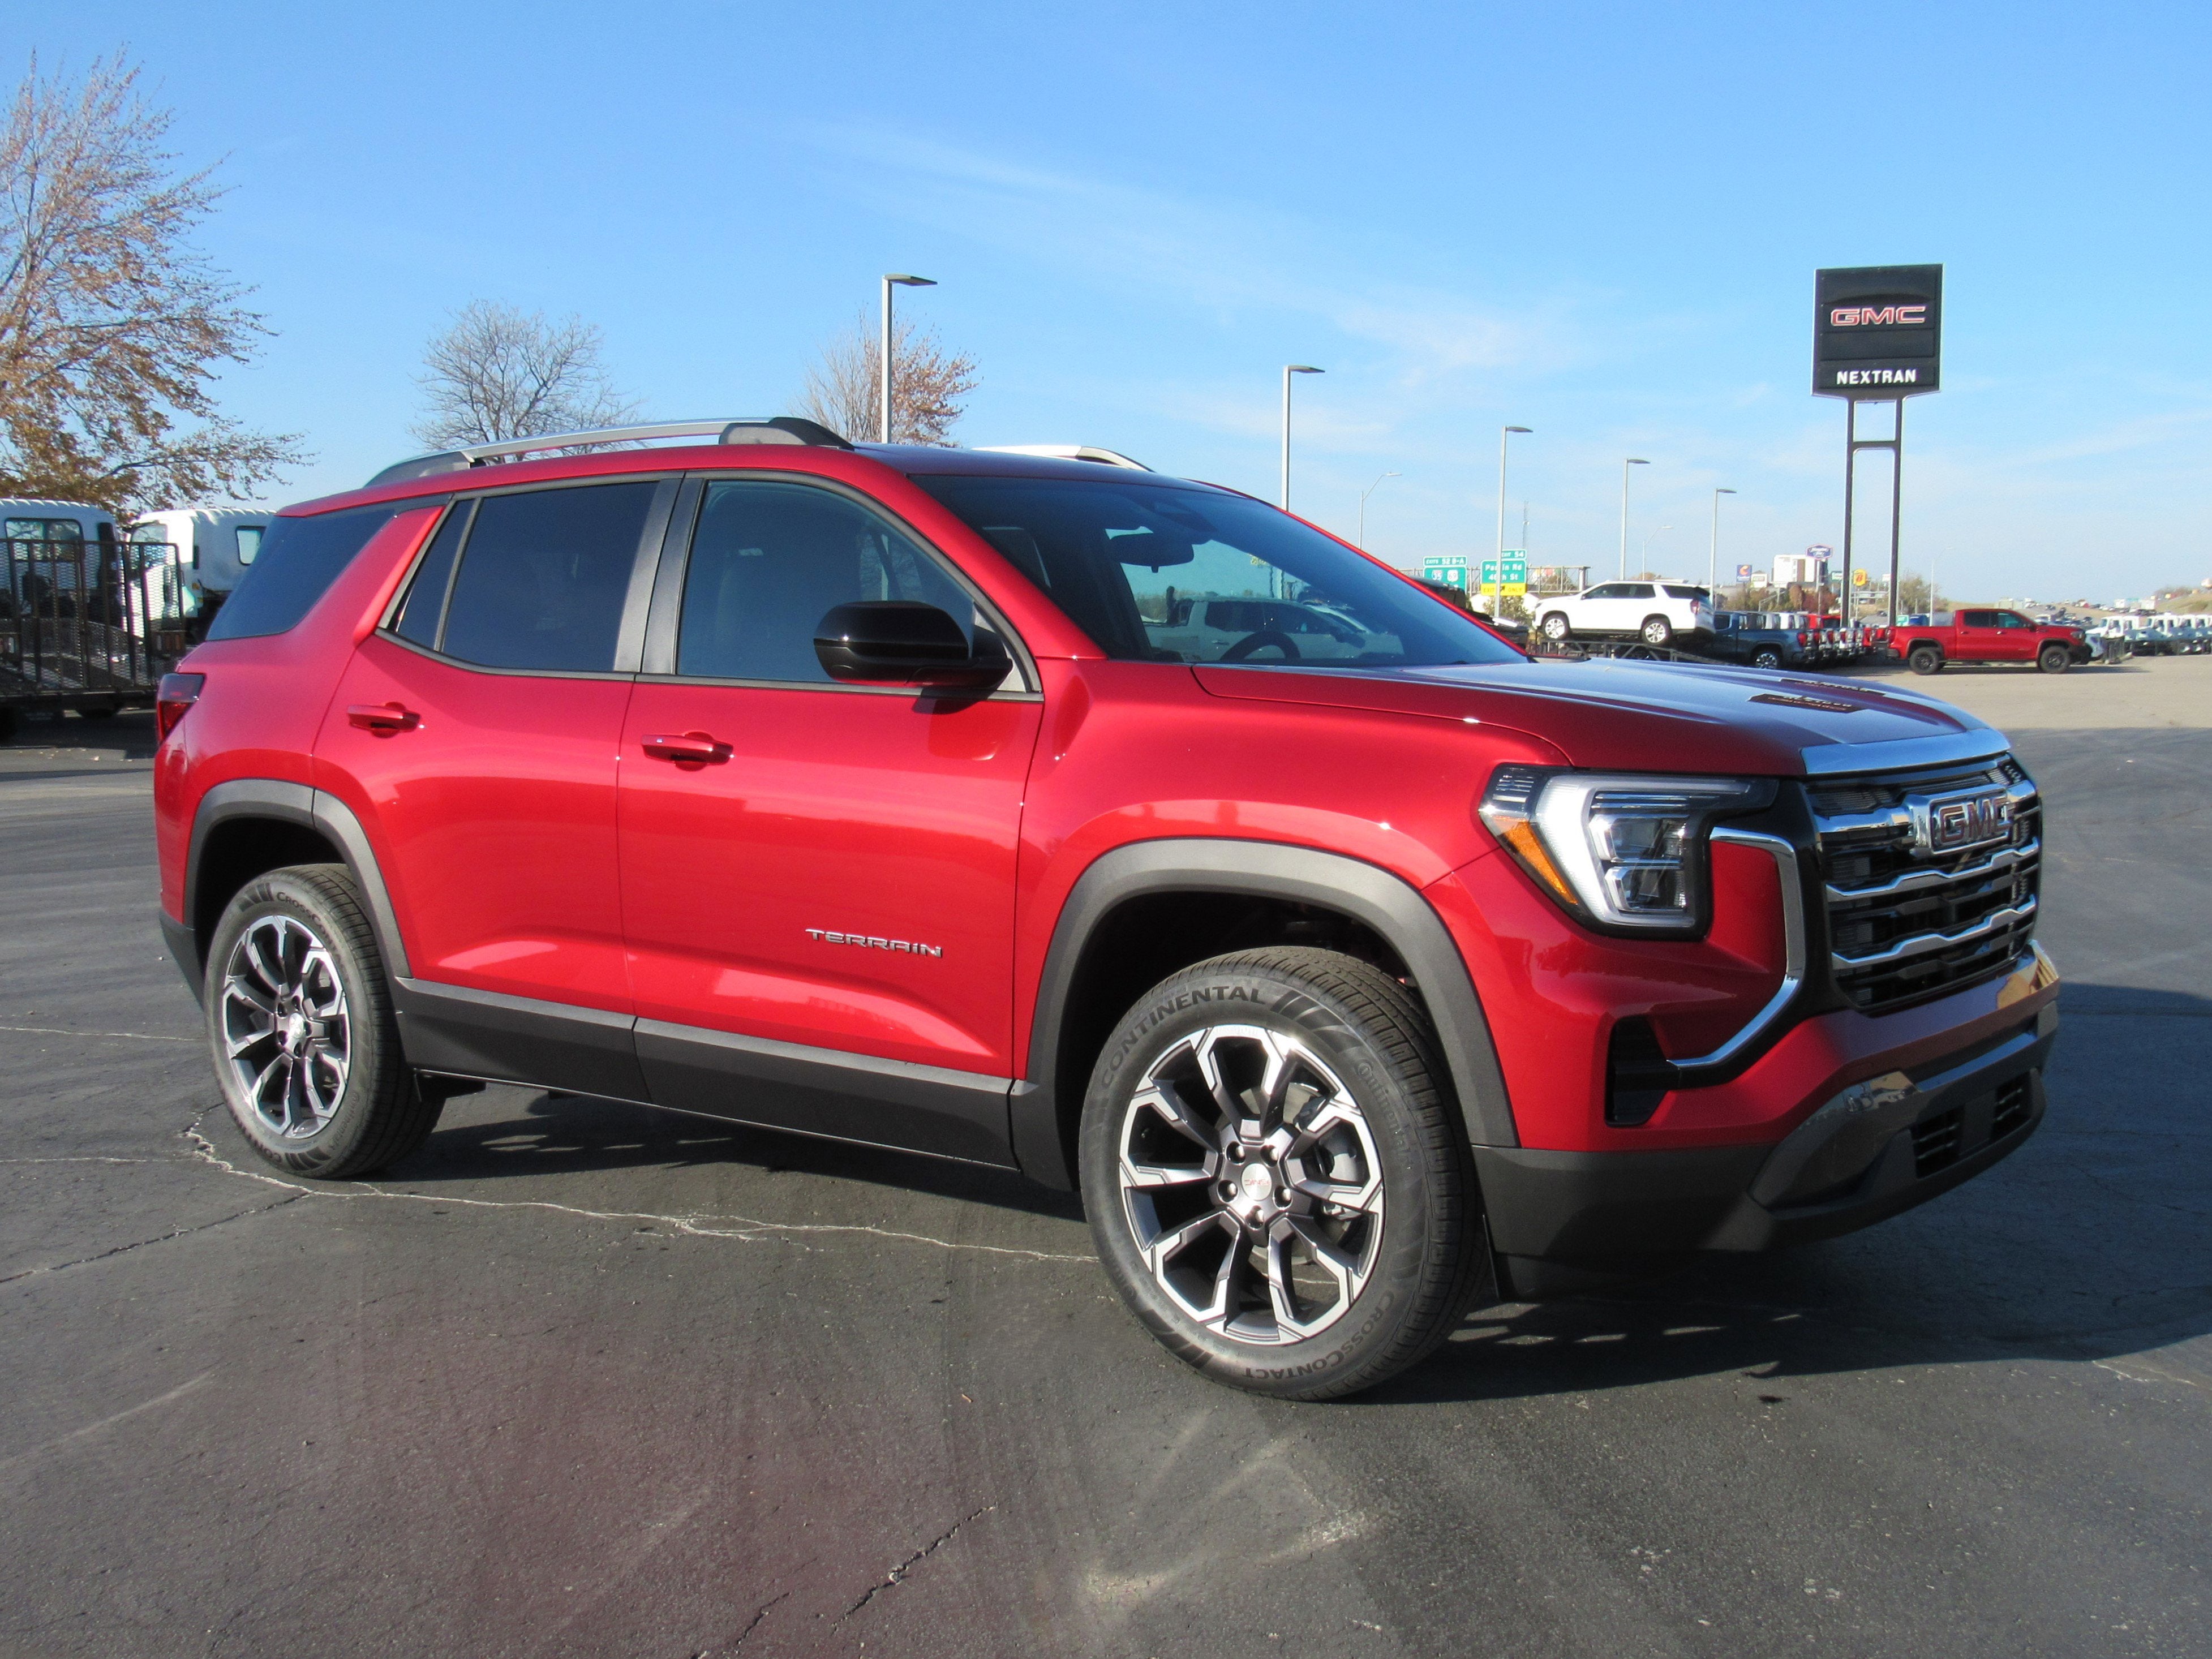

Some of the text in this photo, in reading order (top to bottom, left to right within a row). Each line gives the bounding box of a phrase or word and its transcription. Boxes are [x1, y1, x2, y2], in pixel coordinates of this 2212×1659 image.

[1831, 306, 1926, 326] GMC
[1837, 369, 1916, 385] NEXTRAN
[1939, 795, 2013, 845] GMC
[805, 929, 942, 957] TERRAIN
[1101, 986, 1265, 1088] CONTINENTAL
